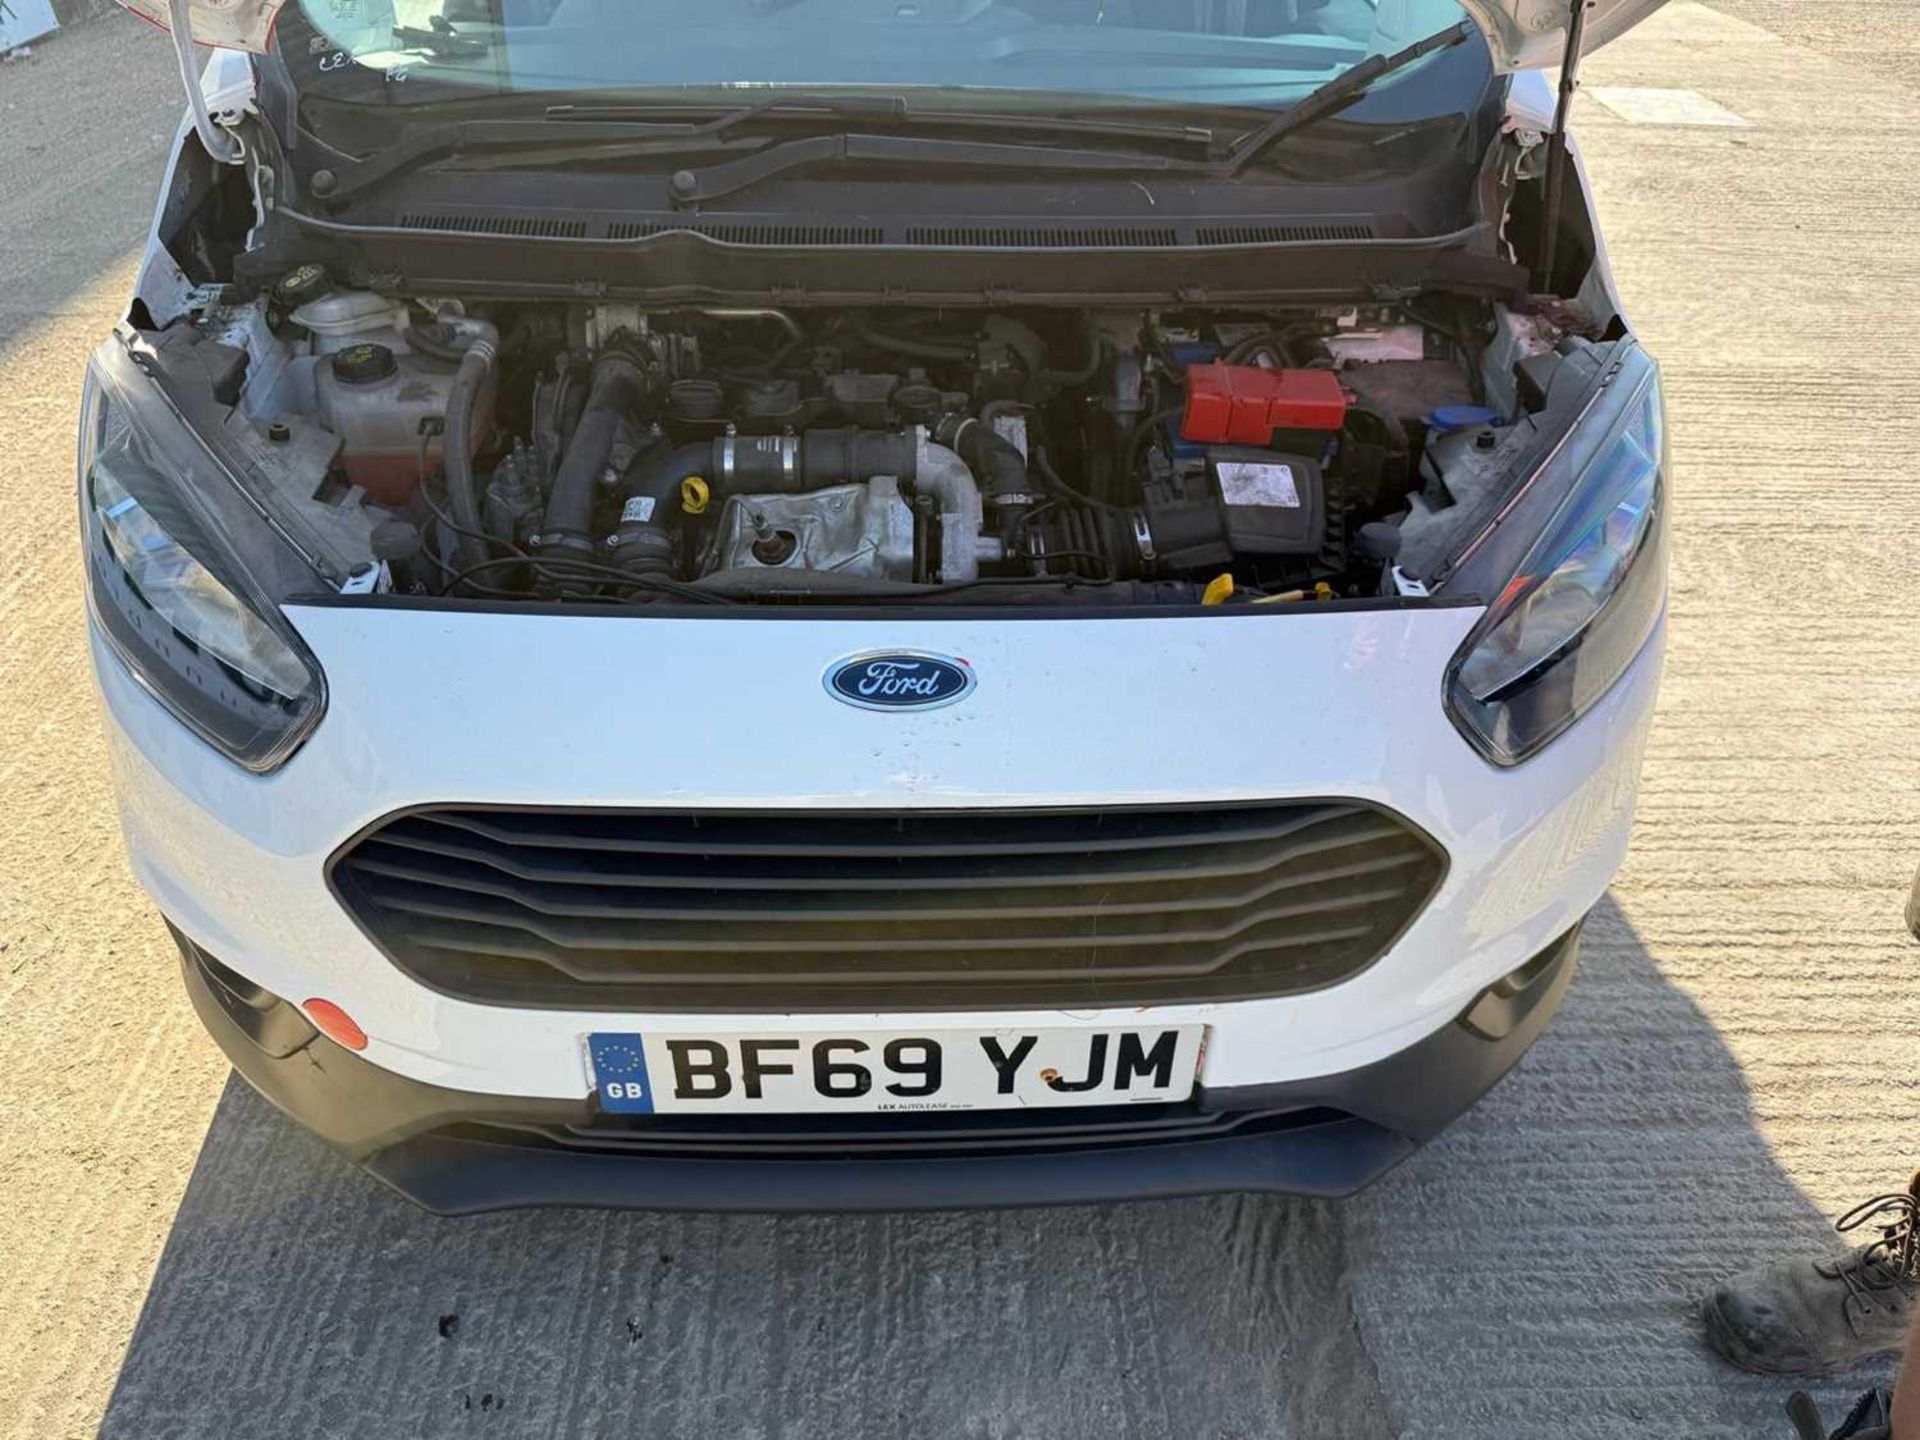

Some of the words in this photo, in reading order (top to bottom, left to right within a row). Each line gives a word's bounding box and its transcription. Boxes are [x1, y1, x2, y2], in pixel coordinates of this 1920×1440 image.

[858, 661, 941, 695] Ford
[665, 1037, 943, 1099] BF69
[979, 1030, 1179, 1095] YJM
[607, 1082, 643, 1099] GB
